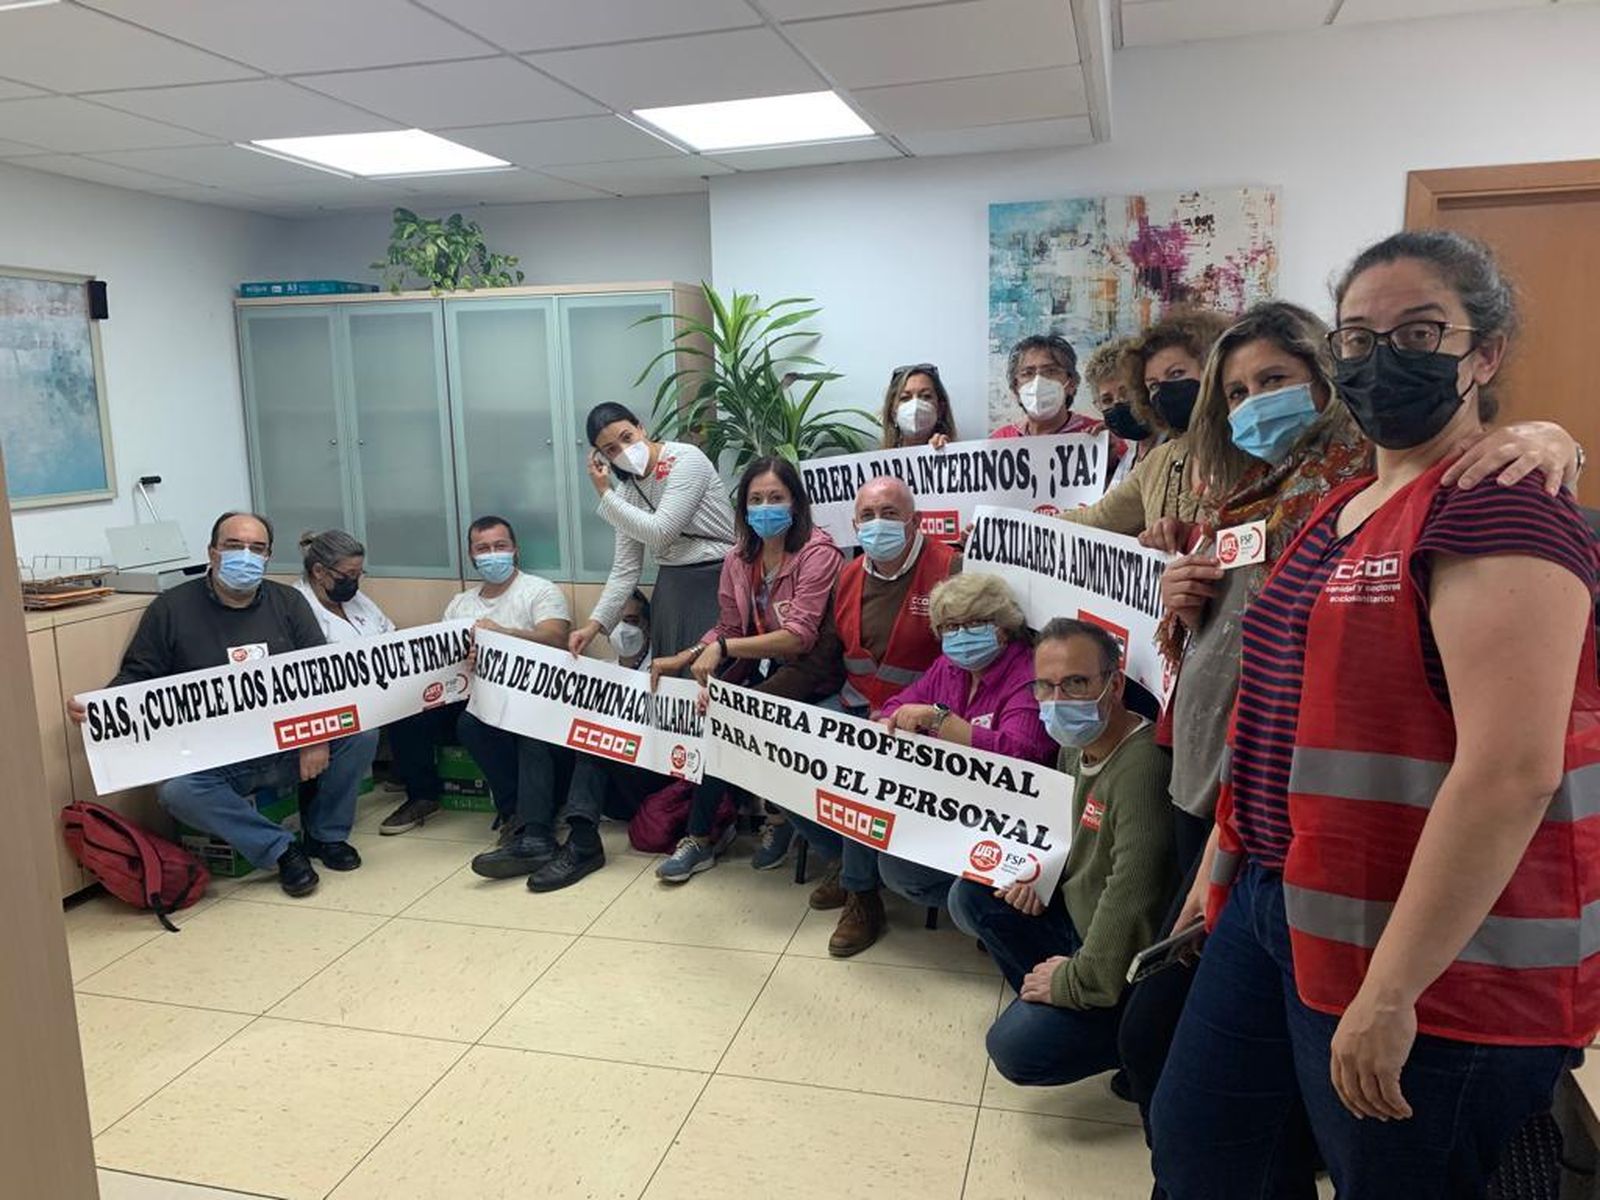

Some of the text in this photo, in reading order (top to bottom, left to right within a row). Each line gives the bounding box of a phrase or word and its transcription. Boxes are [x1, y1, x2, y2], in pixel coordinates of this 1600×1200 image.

[802, 463, 866, 504] RRERA
[917, 445, 1038, 498] INTERINOS,
[1049, 445, 1098, 499] ¡YA!
[967, 516, 1165, 619] AUXILIARES A ADMINISTRATI
[1335, 558, 1398, 579] CCOO
[86, 628, 471, 742] SAS, ¡CUMPLE LOS ACUERDOS QUE FIRMAS
[474, 643, 508, 685] ASTA
[507, 655, 535, 691] DE
[280, 721, 341, 743] CCOO
[573, 727, 625, 753] CCOO
[708, 683, 1039, 798] CARRERA PROFESIONAL
[710, 717, 761, 757] PARA
[765, 741, 827, 781] TODO
[834, 765, 868, 796] EL
[876, 778, 1052, 851] PERSONAL
[820, 800, 871, 836] CCOO
[976, 844, 1026, 867] UGT FSP
